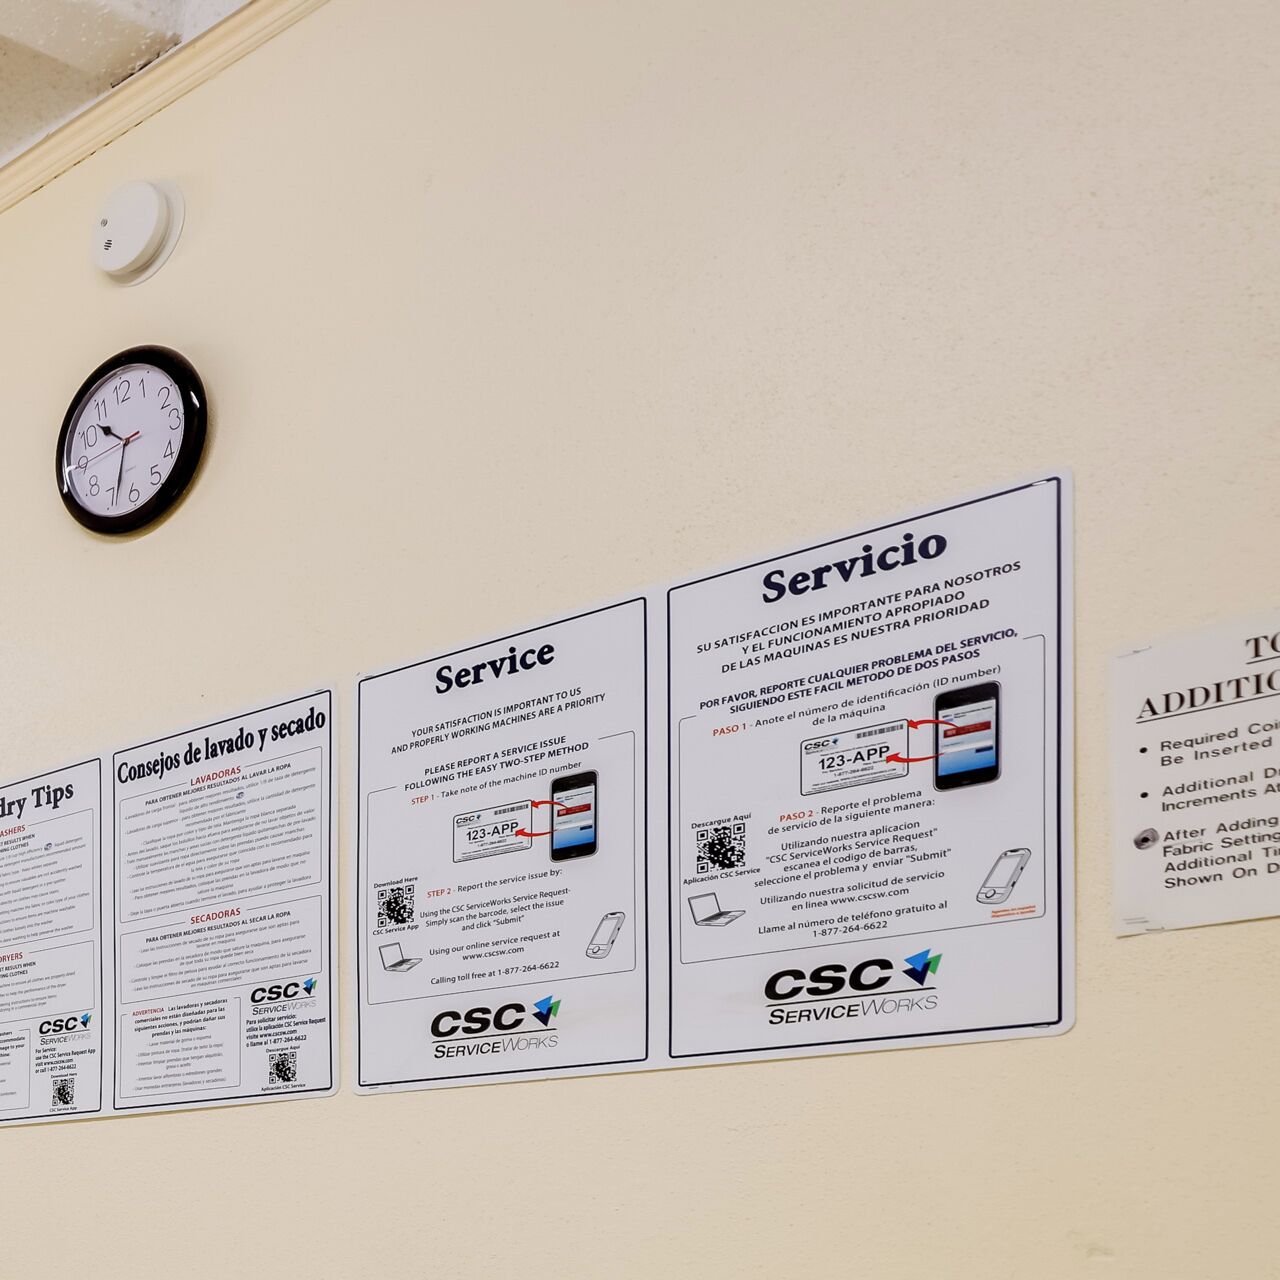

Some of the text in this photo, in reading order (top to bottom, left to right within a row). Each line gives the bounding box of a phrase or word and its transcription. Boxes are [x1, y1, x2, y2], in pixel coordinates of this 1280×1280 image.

[112, 379, 131, 405] 12
[139, 378, 146, 398] 1
[157, 386, 171, 410] 2
[94, 398, 107, 421] 11
[168, 408, 181, 430] 3
[80, 424, 97, 450] 10
[163, 439, 175, 460] 4
[78, 455, 89, 474] 9
[150, 464, 162, 486] 5
[88, 475, 100, 496] 8
[105, 487, 116, 507] 7
[128, 482, 140, 503] 6
[762, 534, 947, 603] Servicio
[697, 561, 1021, 654] SU SATISFACCION ES IMPORTANTE PARA NOSOTROS
[742, 591, 965, 655] Y EL FUNCIONAMIENTO APROPIADO
[722, 599, 989, 673] DE LAS MAQUINAS ES NUESTRA PRIORIDAD
[436, 644, 554, 694] Service
[392, 693, 605, 754] AND PROPERLY WORKING MACHINES ARE A PRIORITY
[412, 687, 581, 737] YOUR SATISFACTION IS IMPORTANT TO US
[118, 708, 326, 784] Consejos de lavado y secado
[1161, 722, 1280, 752] Required Coi
[819, 746, 890, 770] 123-APP
[1161, 736, 1272, 766] Be Inserted
[190, 766, 241, 786] LAVADORAS
[1162, 768, 1280, 796] Additional D
[31, 784, 74, 810] Tips
[1162, 789, 1257, 812] Increments
[466, 822, 519, 841] 123-APP
[1164, 817, 1278, 842] After Adding
[1163, 843, 1213, 857] Fabric
[1164, 847, 1280, 872] Additional Ti
[1164, 874, 1222, 888] Shown
[1232, 868, 1257, 878] On
[830, 888, 909, 905] www.cscsw.com
[190, 908, 240, 924] SECADORAS
[813, 920, 887, 937] 1-877-264-6622
[462, 947, 524, 960] www.cscsw.com
[458, 973, 470, 981] toll
[498, 961, 559, 975] 1-877-264-6622
[764, 959, 894, 1000] CSC
[250, 982, 301, 1003] CSC
[39, 1017, 78, 1034] CSC
[431, 1003, 526, 1038] CSC
